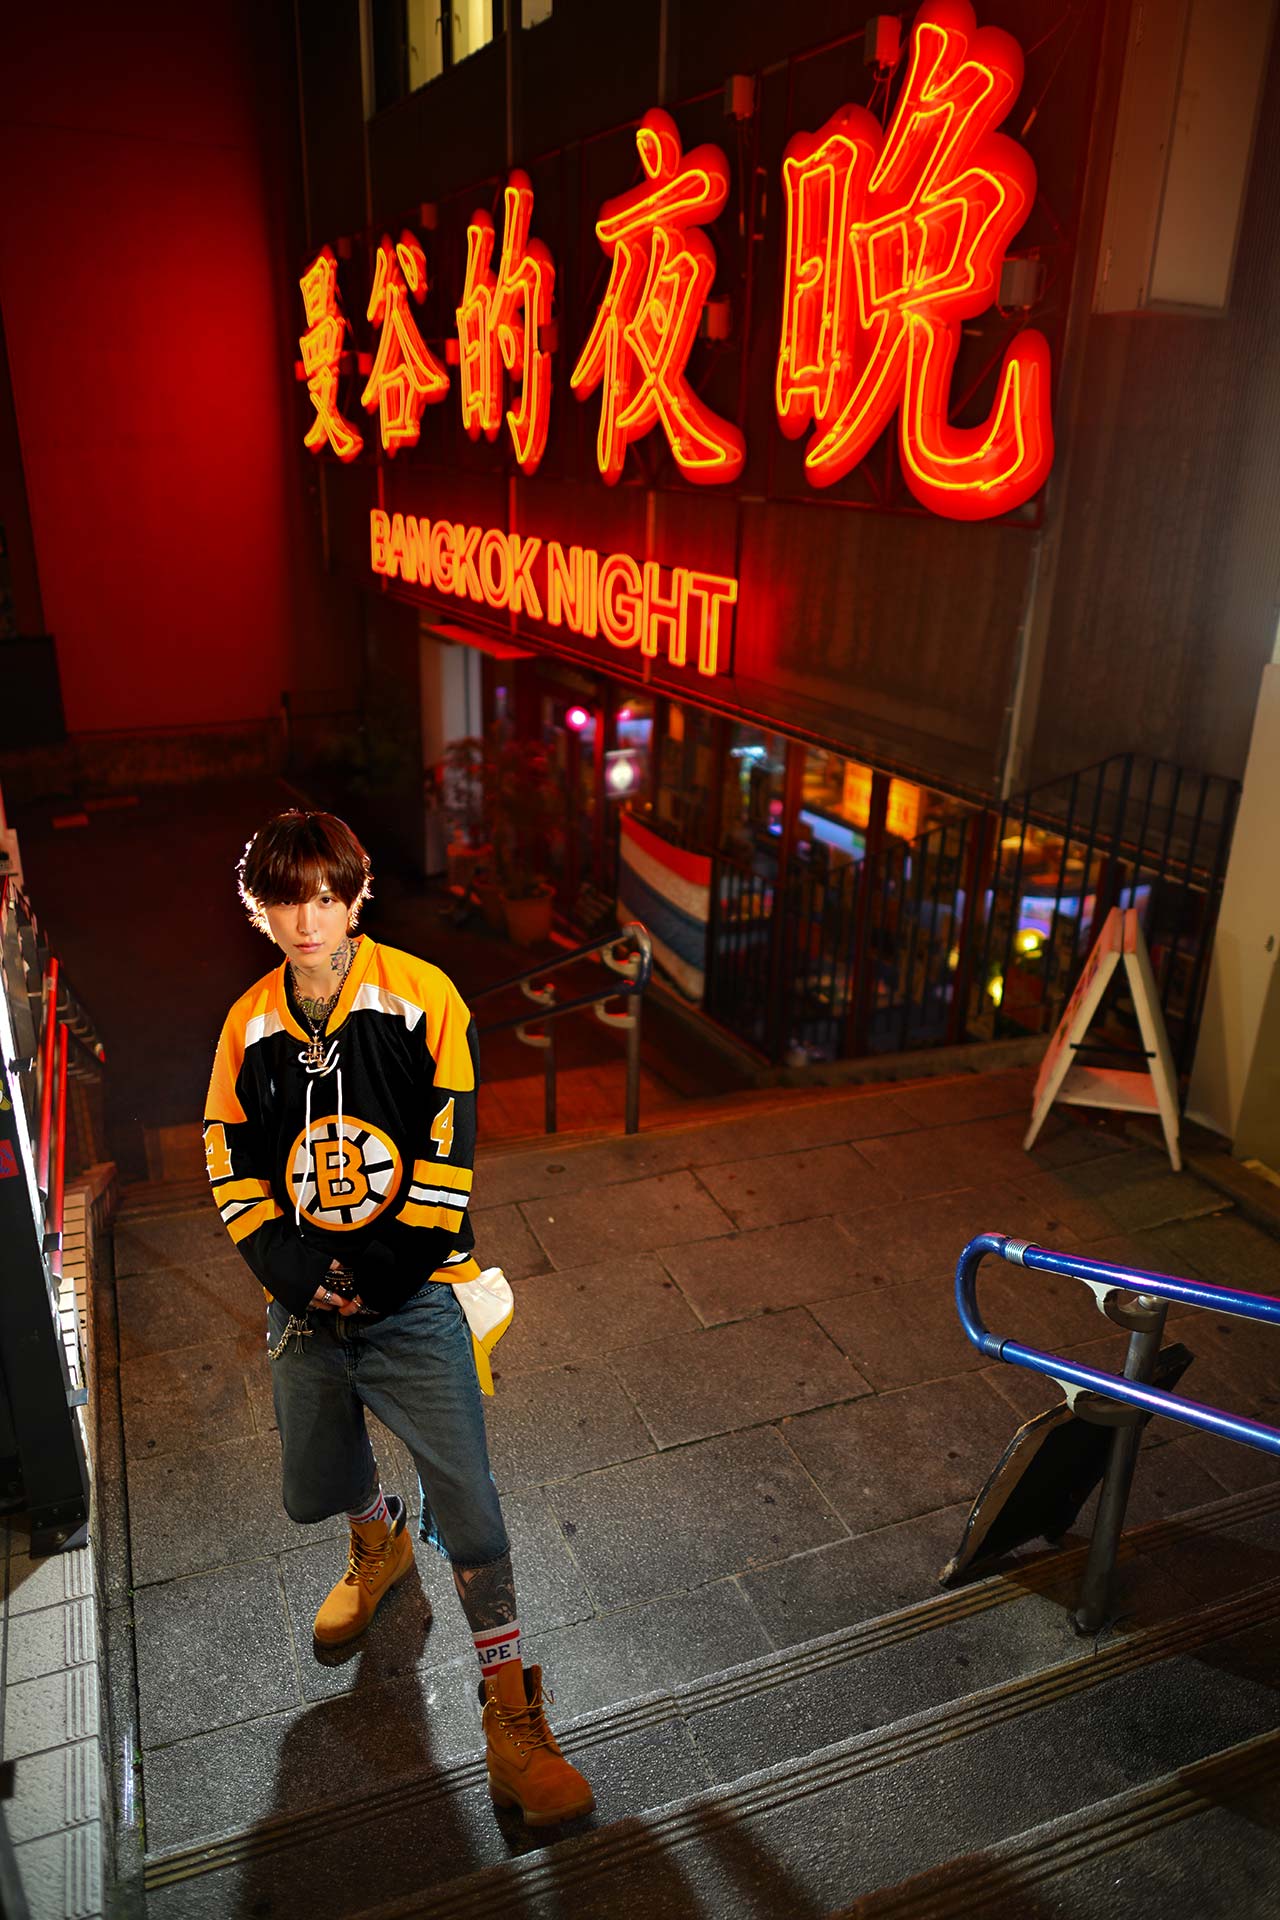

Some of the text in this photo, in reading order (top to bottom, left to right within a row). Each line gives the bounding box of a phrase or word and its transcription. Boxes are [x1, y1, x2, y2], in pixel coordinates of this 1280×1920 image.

[296, 0, 1054, 520] 曼谷的夜晚
[370, 509, 738, 676] BANGKOK NIGHT
[203, 1123, 234, 1181] 4
[430, 1097, 454, 1157] 4
[312, 1137, 370, 1210] B
